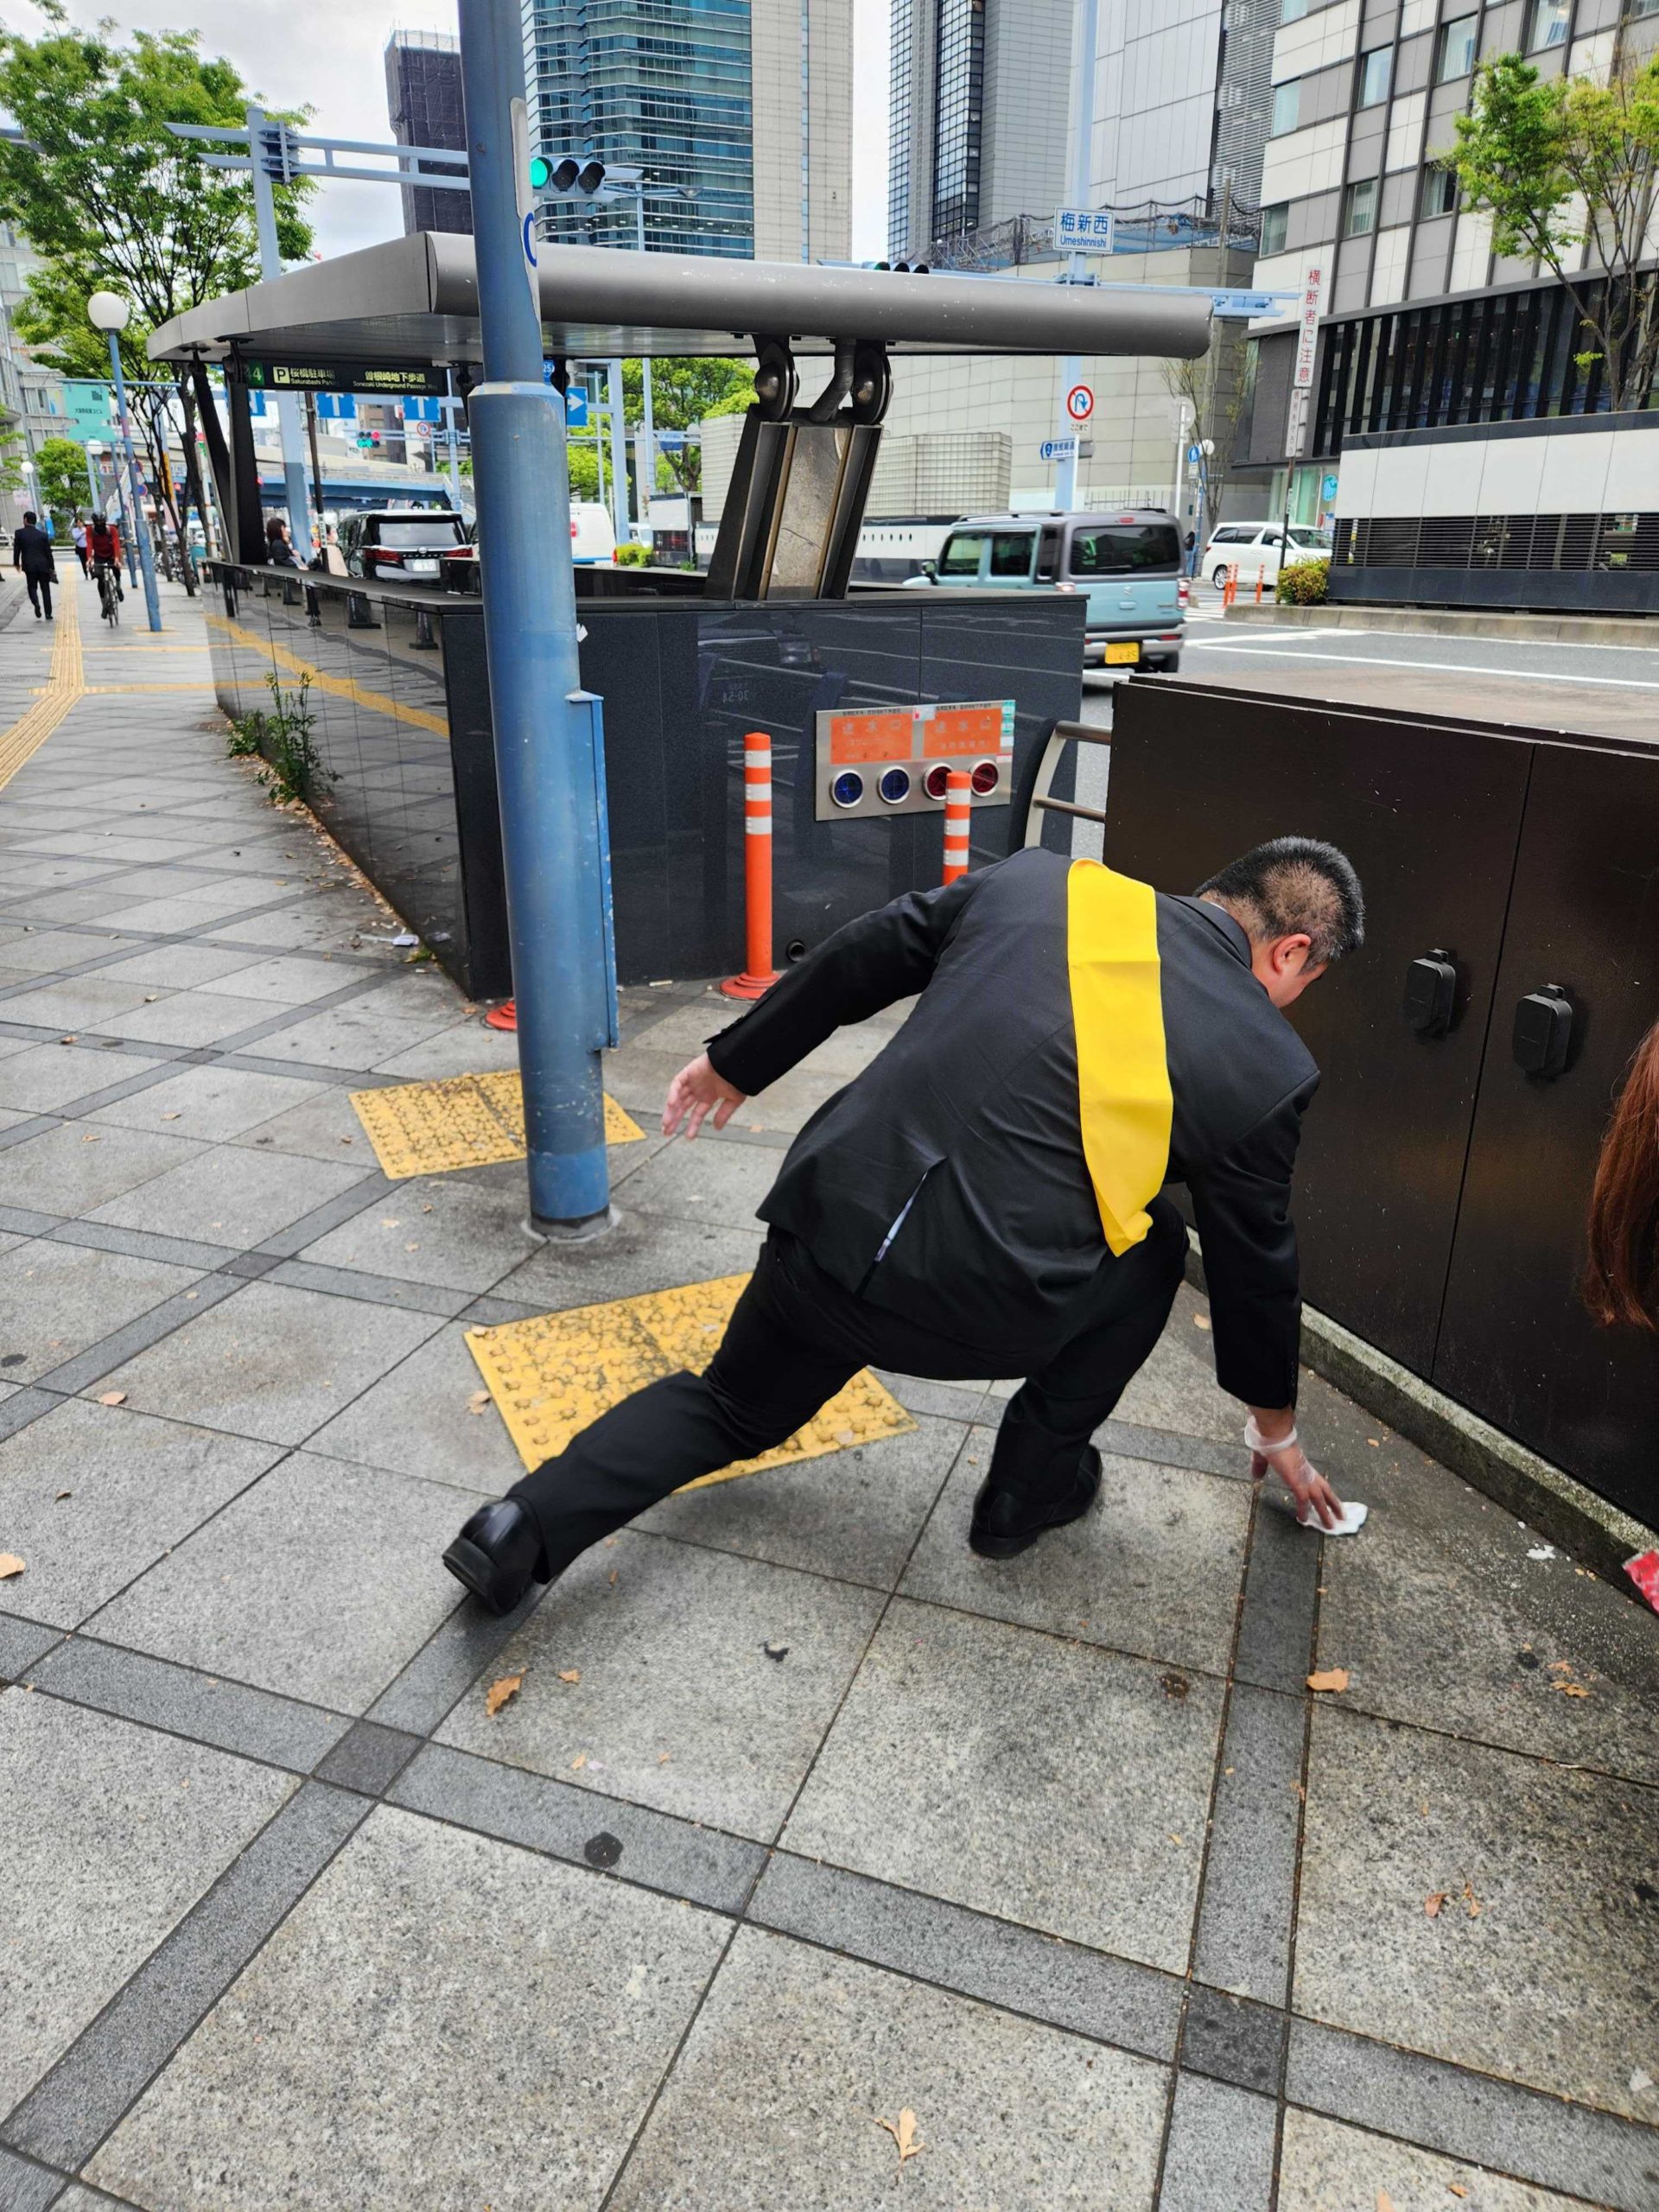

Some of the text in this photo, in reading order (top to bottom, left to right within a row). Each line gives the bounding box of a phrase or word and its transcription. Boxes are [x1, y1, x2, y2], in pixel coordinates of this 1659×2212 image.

[1060, 213, 1109, 234] 梅新西
[1060, 235, 1107, 248] Umeshinnishi
[1297, 269, 1321, 383] 横断者に注意
[276, 368, 286, 381] P
[1070, 423, 1089, 432] ここまで
